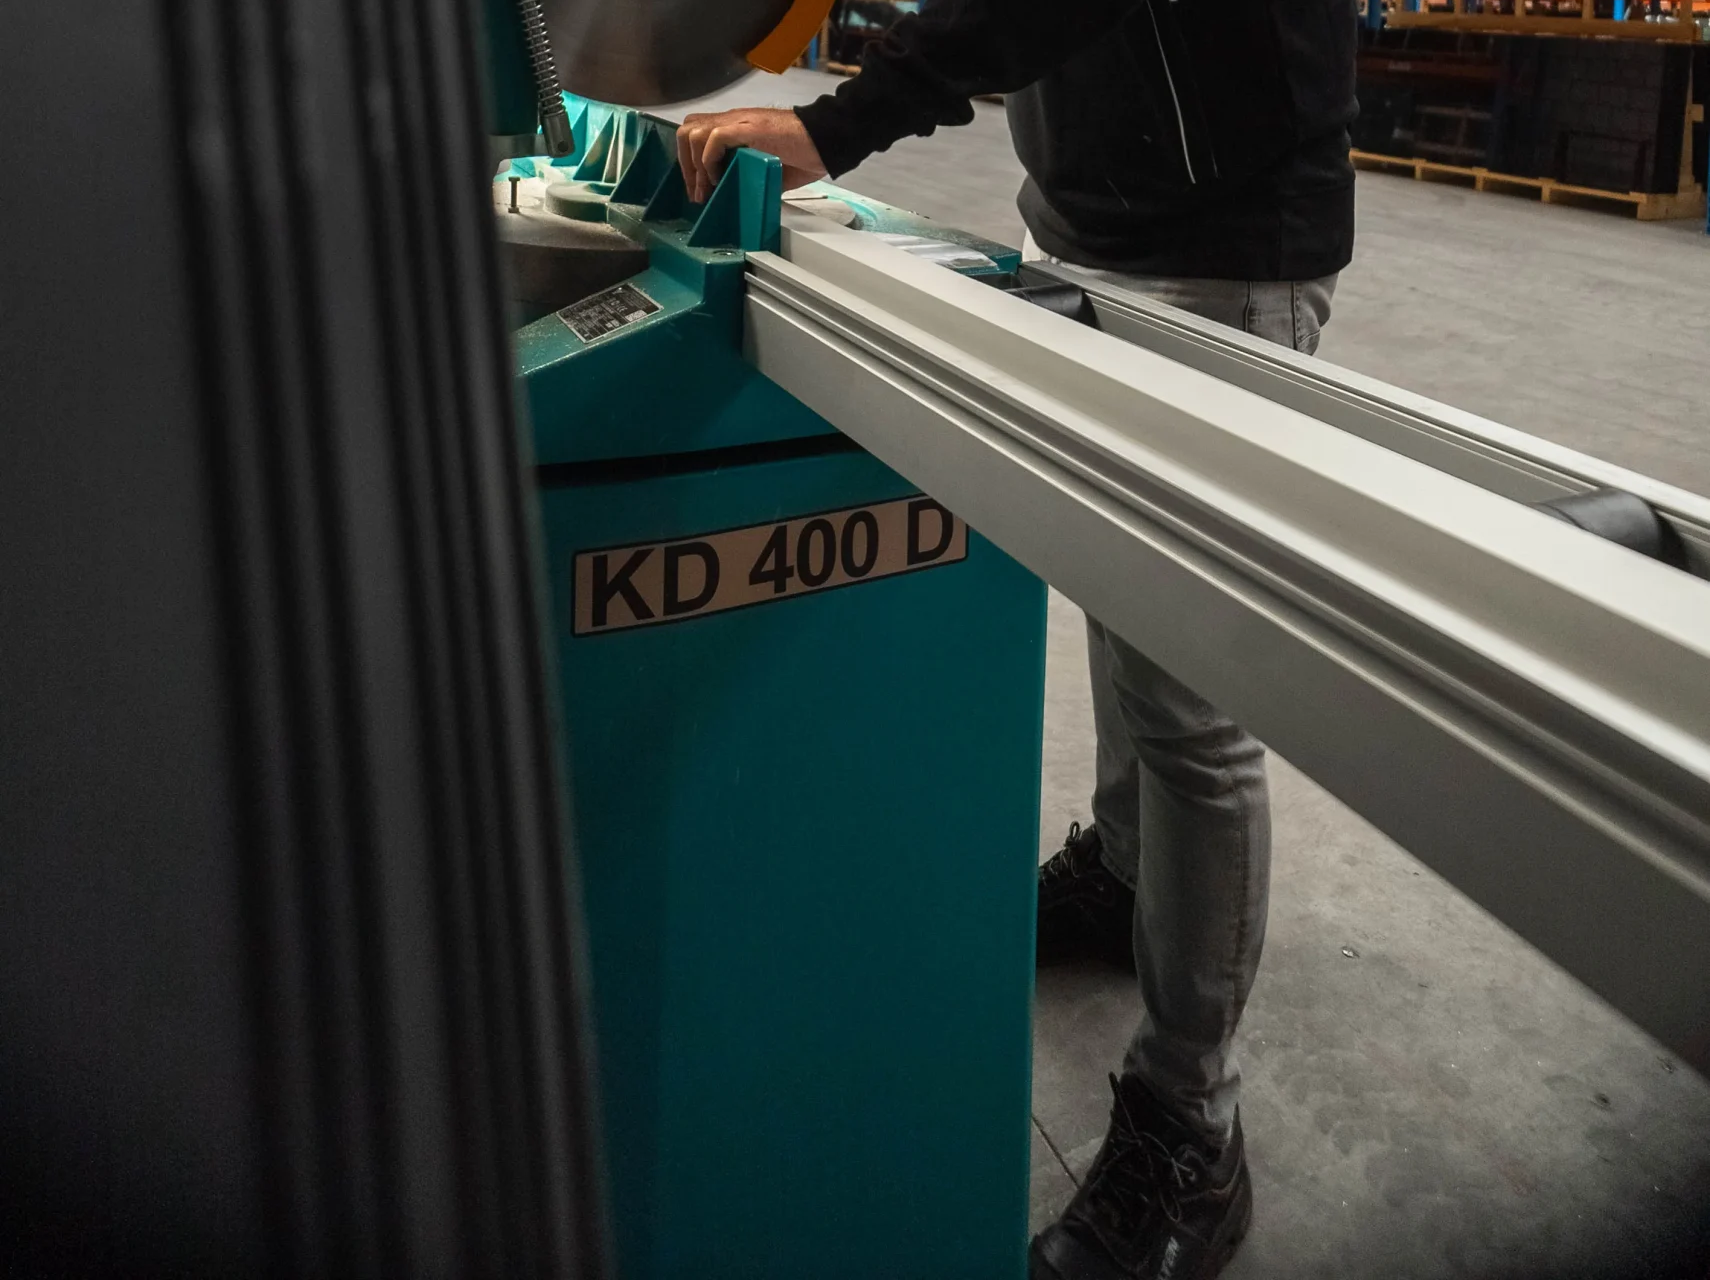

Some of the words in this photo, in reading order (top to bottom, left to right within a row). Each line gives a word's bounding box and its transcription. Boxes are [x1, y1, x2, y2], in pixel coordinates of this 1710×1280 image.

[591, 541, 721, 628] KD
[748, 510, 879, 595] 400
[906, 497, 954, 567] D
